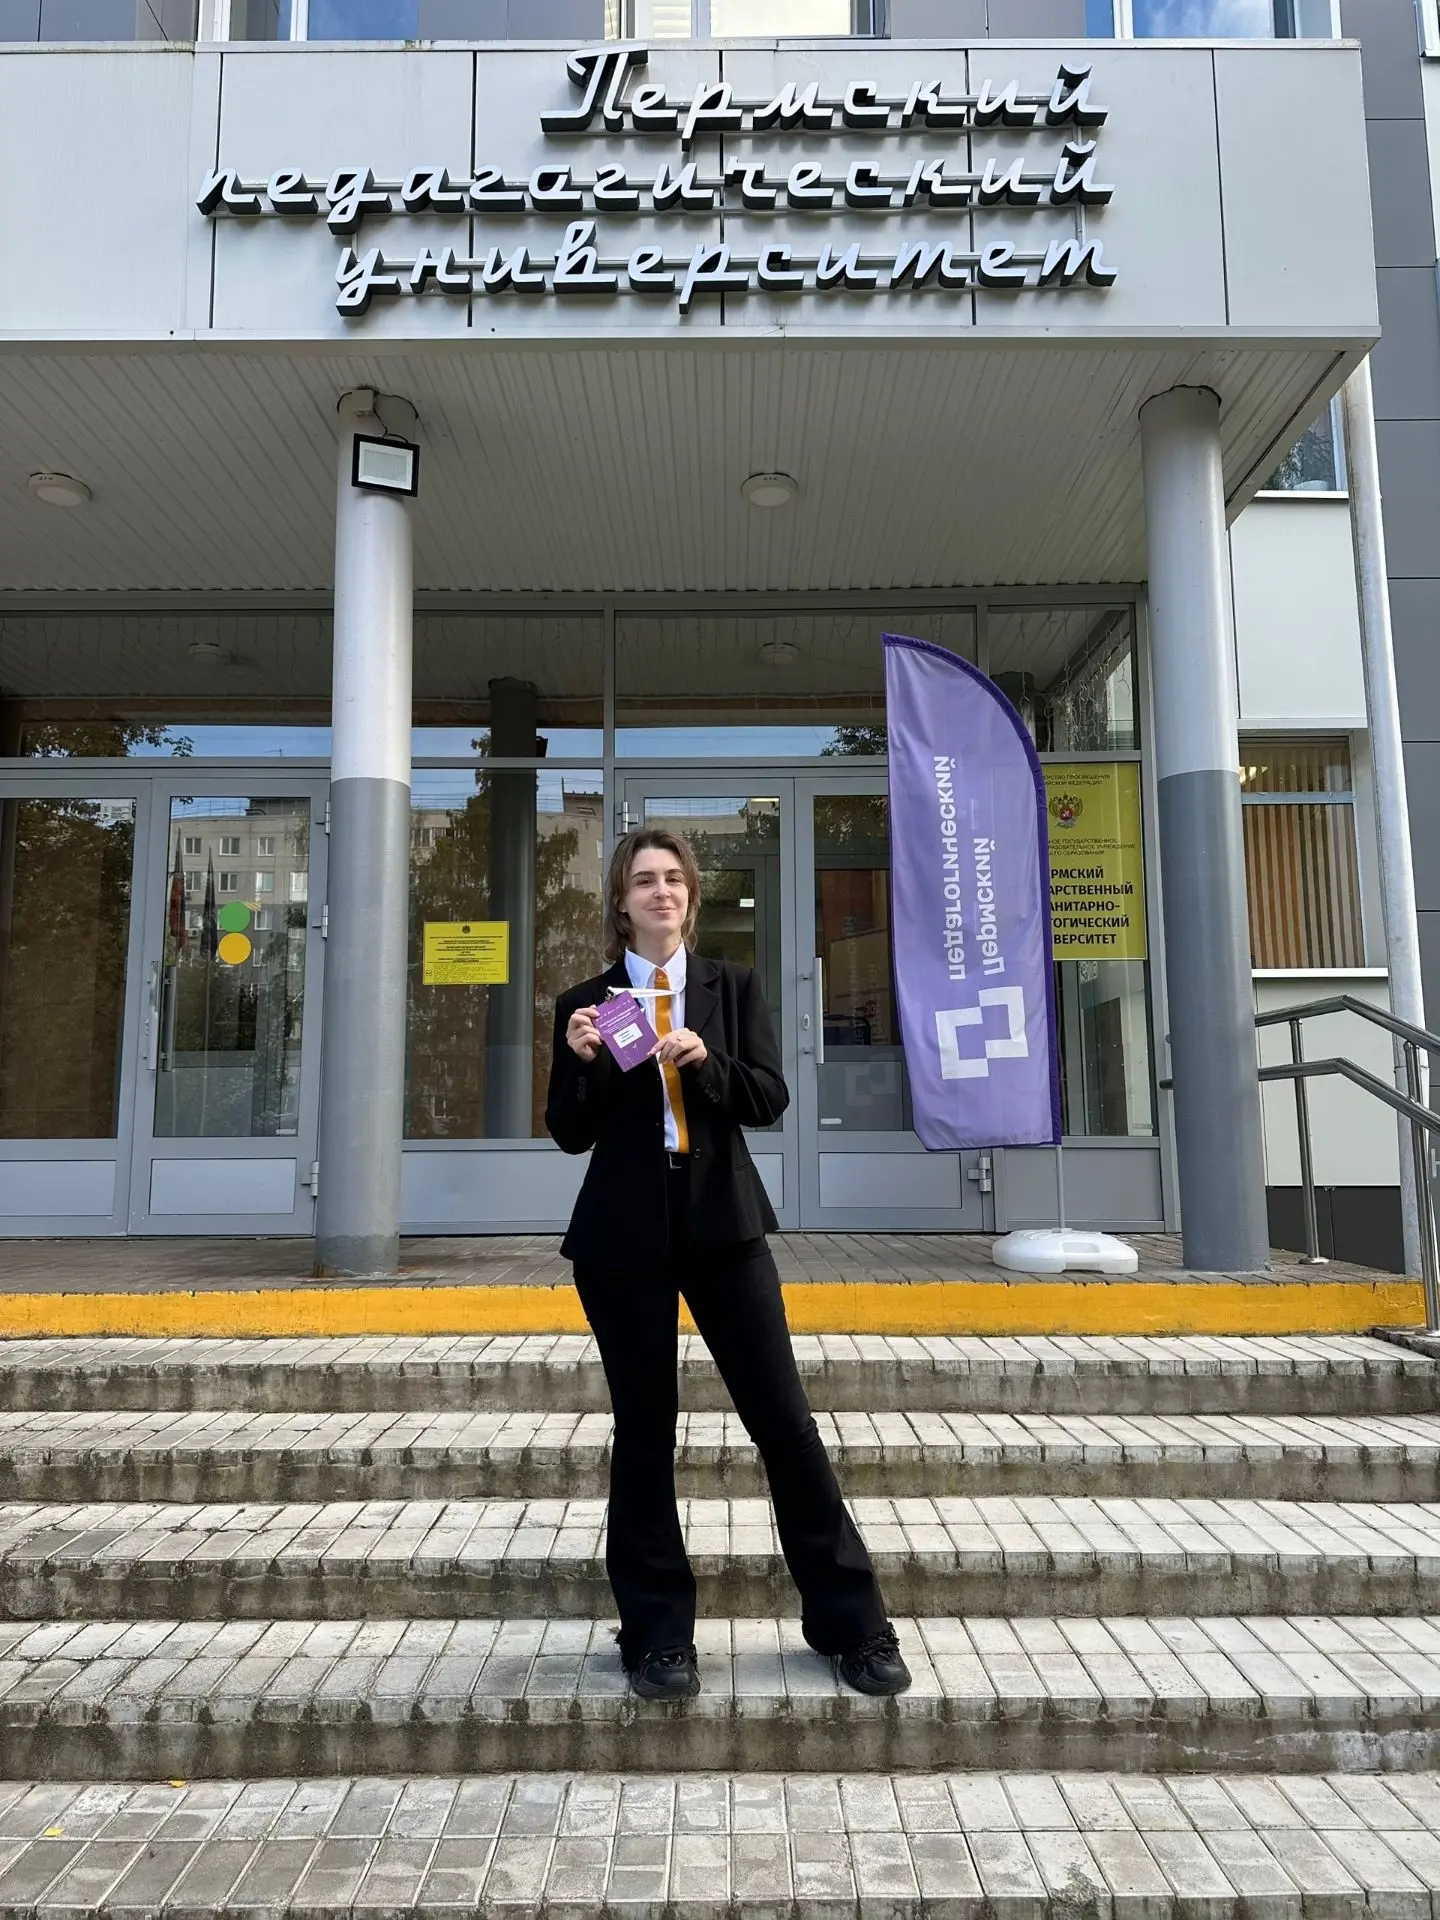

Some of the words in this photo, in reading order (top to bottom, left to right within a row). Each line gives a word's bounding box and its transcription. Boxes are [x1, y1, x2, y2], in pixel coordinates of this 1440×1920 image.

[540, 43, 1109, 148] Пермский
[197, 140, 1117, 231] педагогический
[335, 221, 1119, 313] университет
[1051, 865, 1104, 879] РМСКИЙ
[1051, 914, 1130, 928] ОГИЧЕСКИЙ
[1053, 933, 1117, 945] ВЕРСИТЕТ
